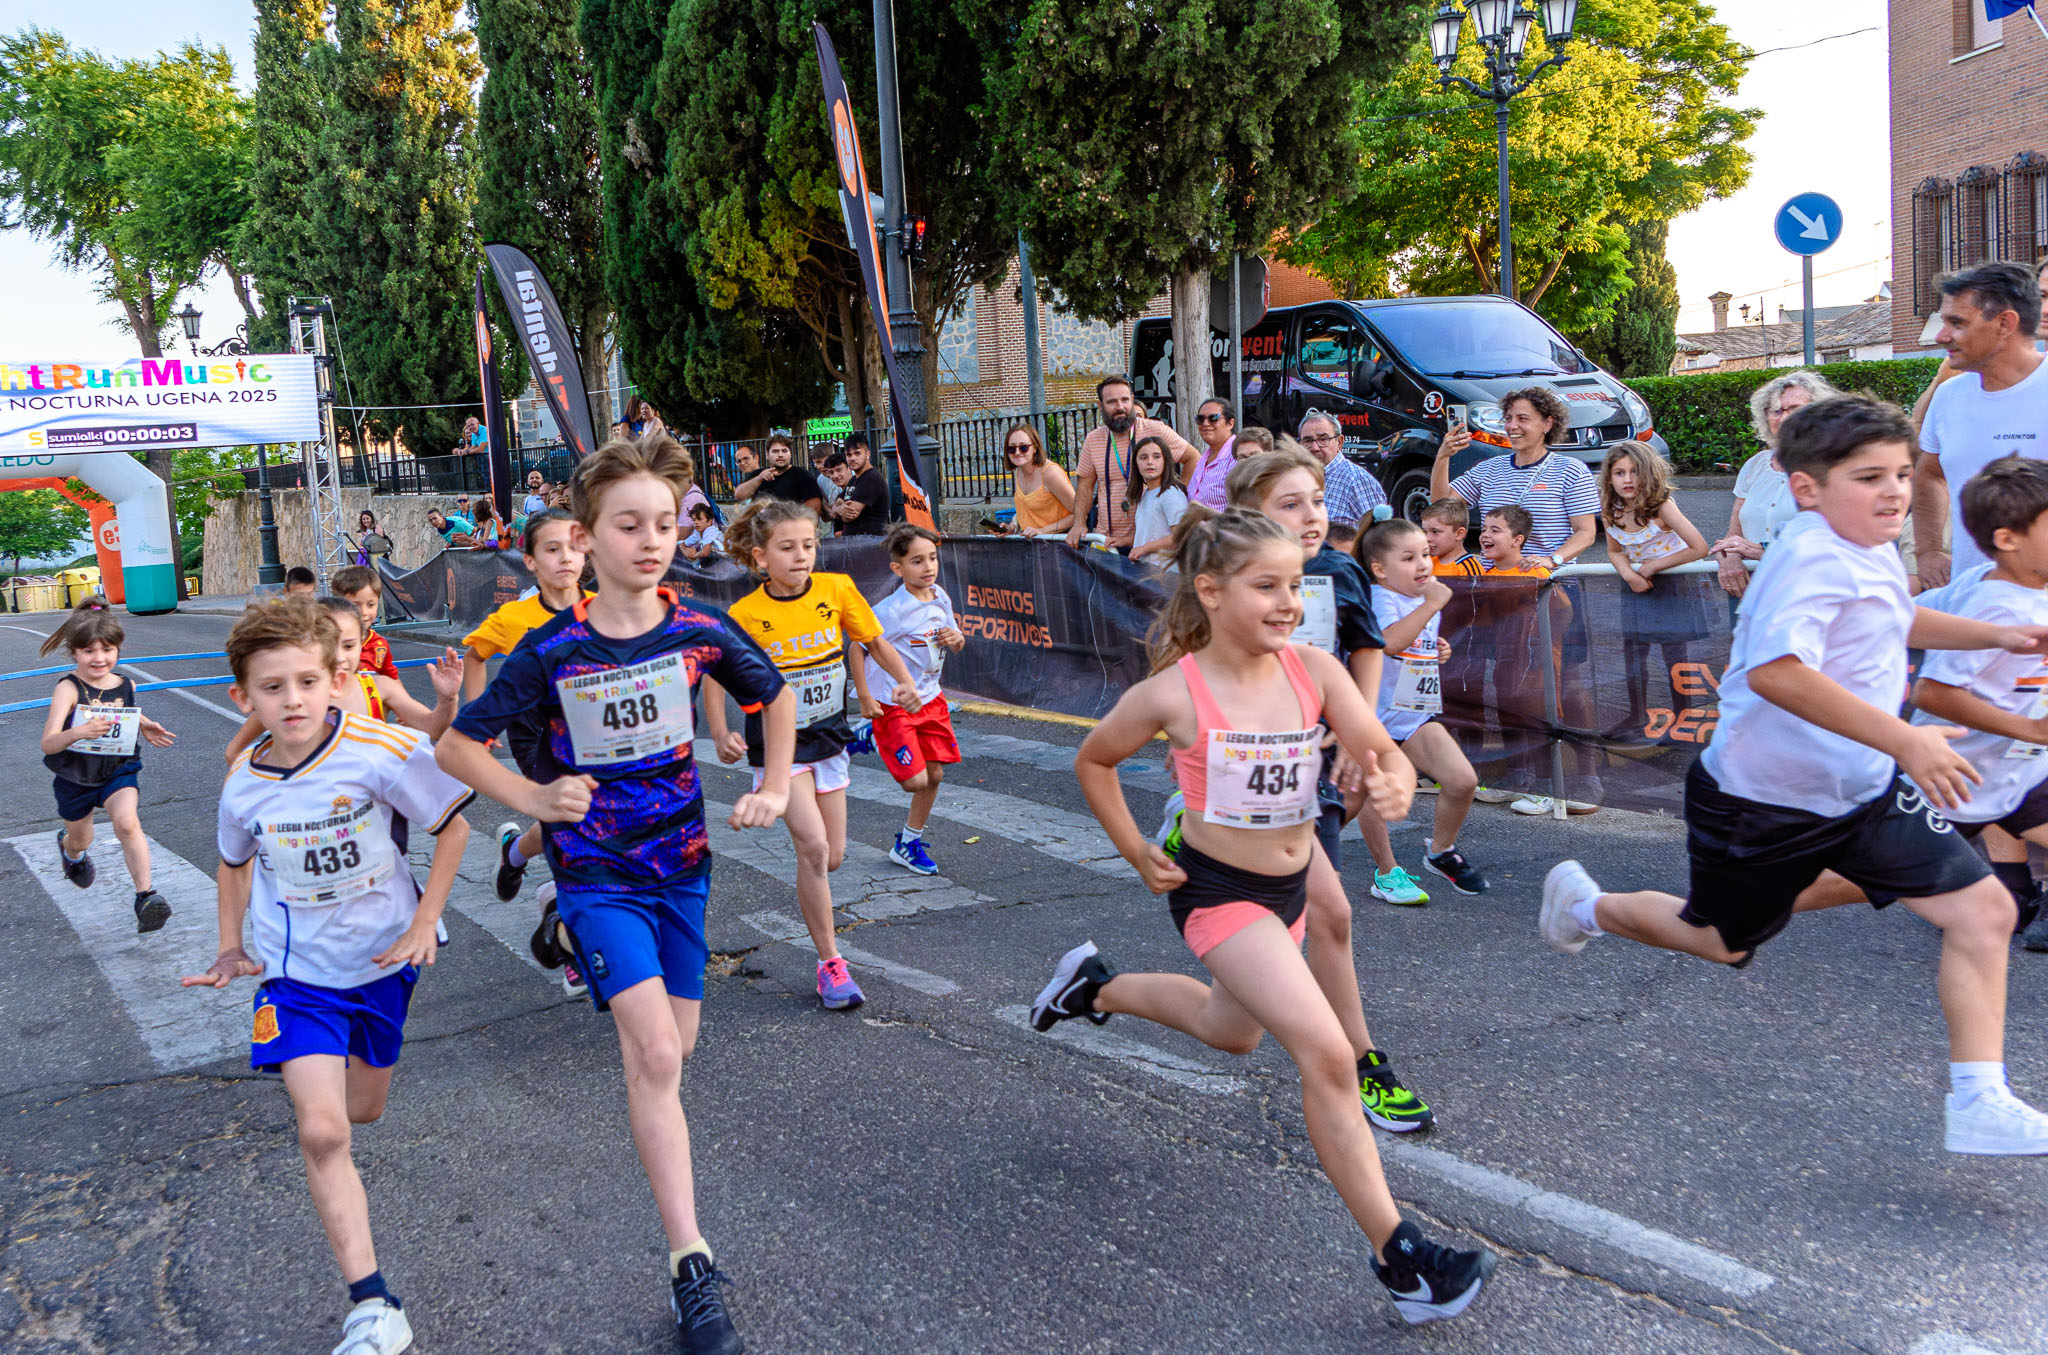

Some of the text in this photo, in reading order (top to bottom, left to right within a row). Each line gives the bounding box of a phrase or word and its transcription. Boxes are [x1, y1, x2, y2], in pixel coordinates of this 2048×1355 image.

[1209, 330, 1284, 358] forvent
[10, 389, 277, 410] NOCTURNA UGENA 2025
[104, 426, 194, 442] 00:00:03
[968, 585, 1034, 615] EVENTOS
[953, 612, 1053, 648] DEPORTIVOS
[574, 675, 602, 688] LEGUA
[650, 656, 678, 673] UGENA
[1416, 677, 1439, 695] 426
[803, 682, 832, 706] 432
[603, 692, 658, 731] 438
[1226, 733, 1256, 744] LEGUA
[1247, 763, 1299, 796] 434
[277, 823, 303, 833] LEGUA
[304, 814, 352, 832] NOCTURNA
[304, 840, 361, 876] 433
